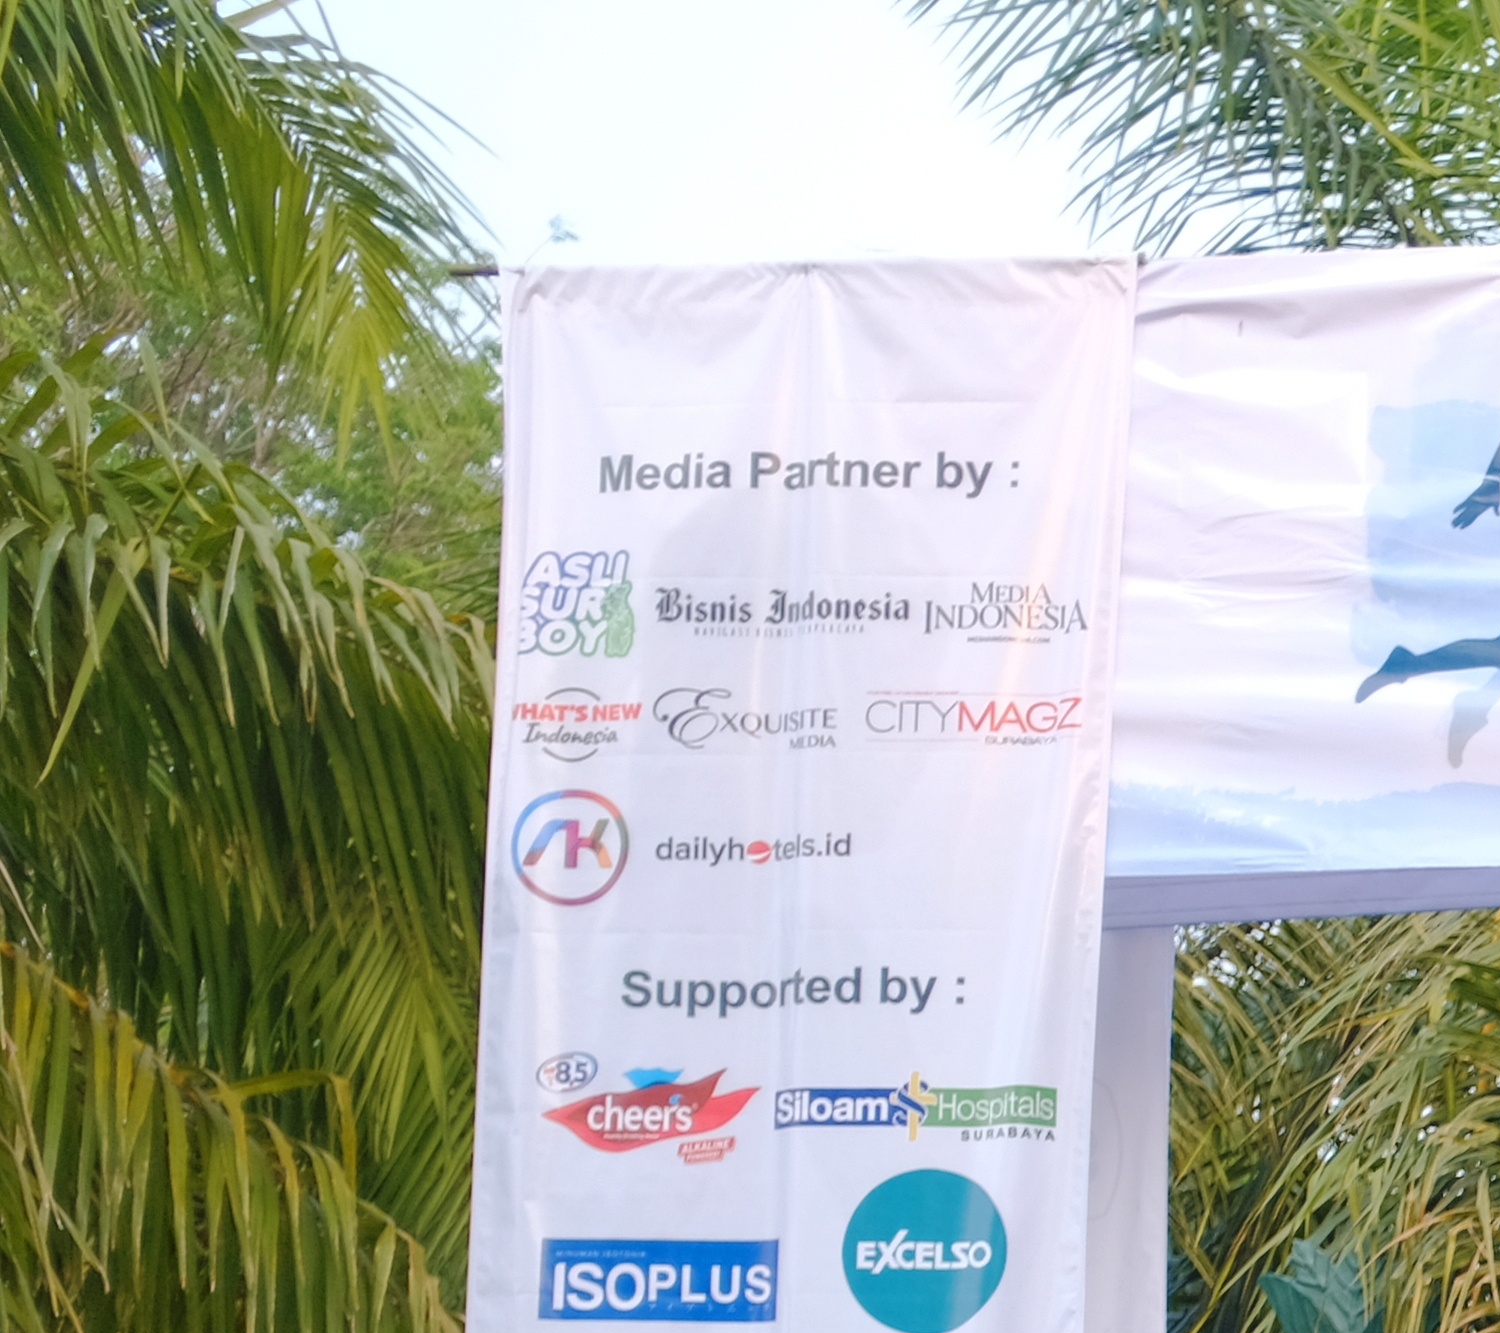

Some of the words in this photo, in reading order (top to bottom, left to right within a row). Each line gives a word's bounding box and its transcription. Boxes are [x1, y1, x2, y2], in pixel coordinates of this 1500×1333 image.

[599, 453, 732, 493] Media
[749, 452, 920, 489] Partner
[936, 452, 993, 498] by
[525, 550, 629, 587] ASLI
[654, 586, 753, 623] Bisnis
[765, 588, 910, 625] Indonesia
[970, 581, 1051, 604] MEDIA
[924, 600, 1088, 634] INDONESIA
[591, 702, 642, 721] NEW
[865, 697, 1083, 733] CITYMAGZ
[522, 721, 618, 745] Indonesia
[789, 734, 836, 750] MEDIA
[621, 967, 863, 1018] Supported
[881, 966, 936, 1014] by
[777, 1090, 890, 1124] Siloam
[938, 1091, 1054, 1125] Hospitals
[961, 1128, 1056, 1142] SURABAYA
[856, 1229, 992, 1275] EXCELSO
[552, 1262, 772, 1311] ISOPLUS
